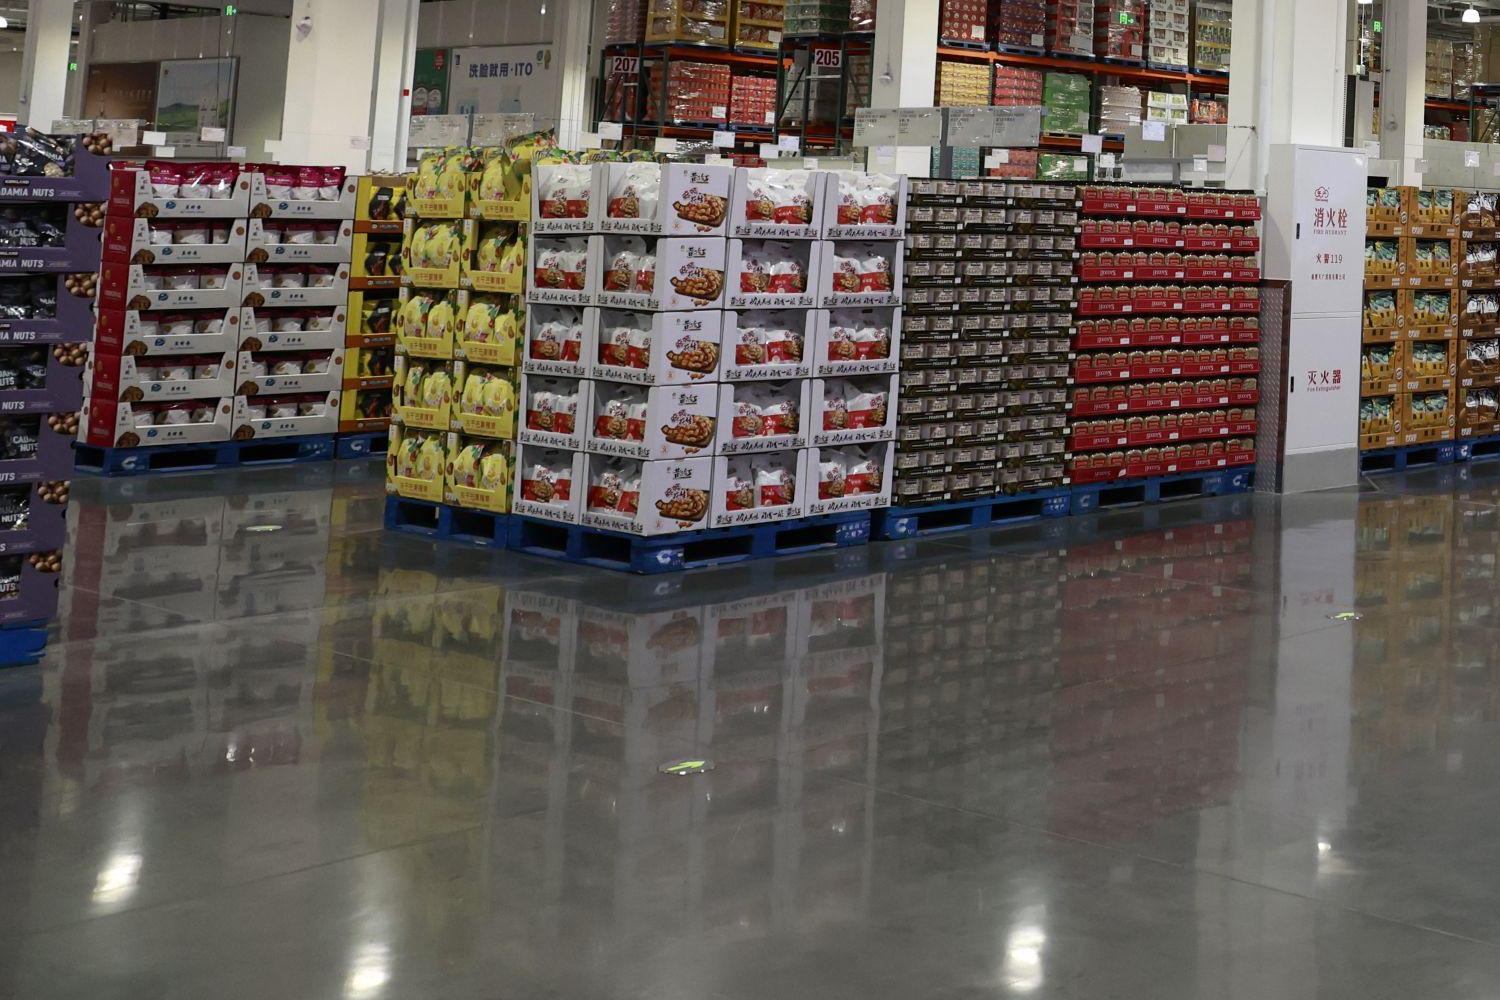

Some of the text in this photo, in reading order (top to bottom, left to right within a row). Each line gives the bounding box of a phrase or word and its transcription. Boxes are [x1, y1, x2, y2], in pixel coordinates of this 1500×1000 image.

[614, 57, 637, 72] 207
[816, 50, 840, 66] 205
[33, 189, 54, 197] NUTS
[1313, 208, 1348, 228] 消火栓
[14, 332, 36, 340] NUTS
[1308, 370, 1341, 384] 灭火器
[2, 402, 25, 410] NUTS
